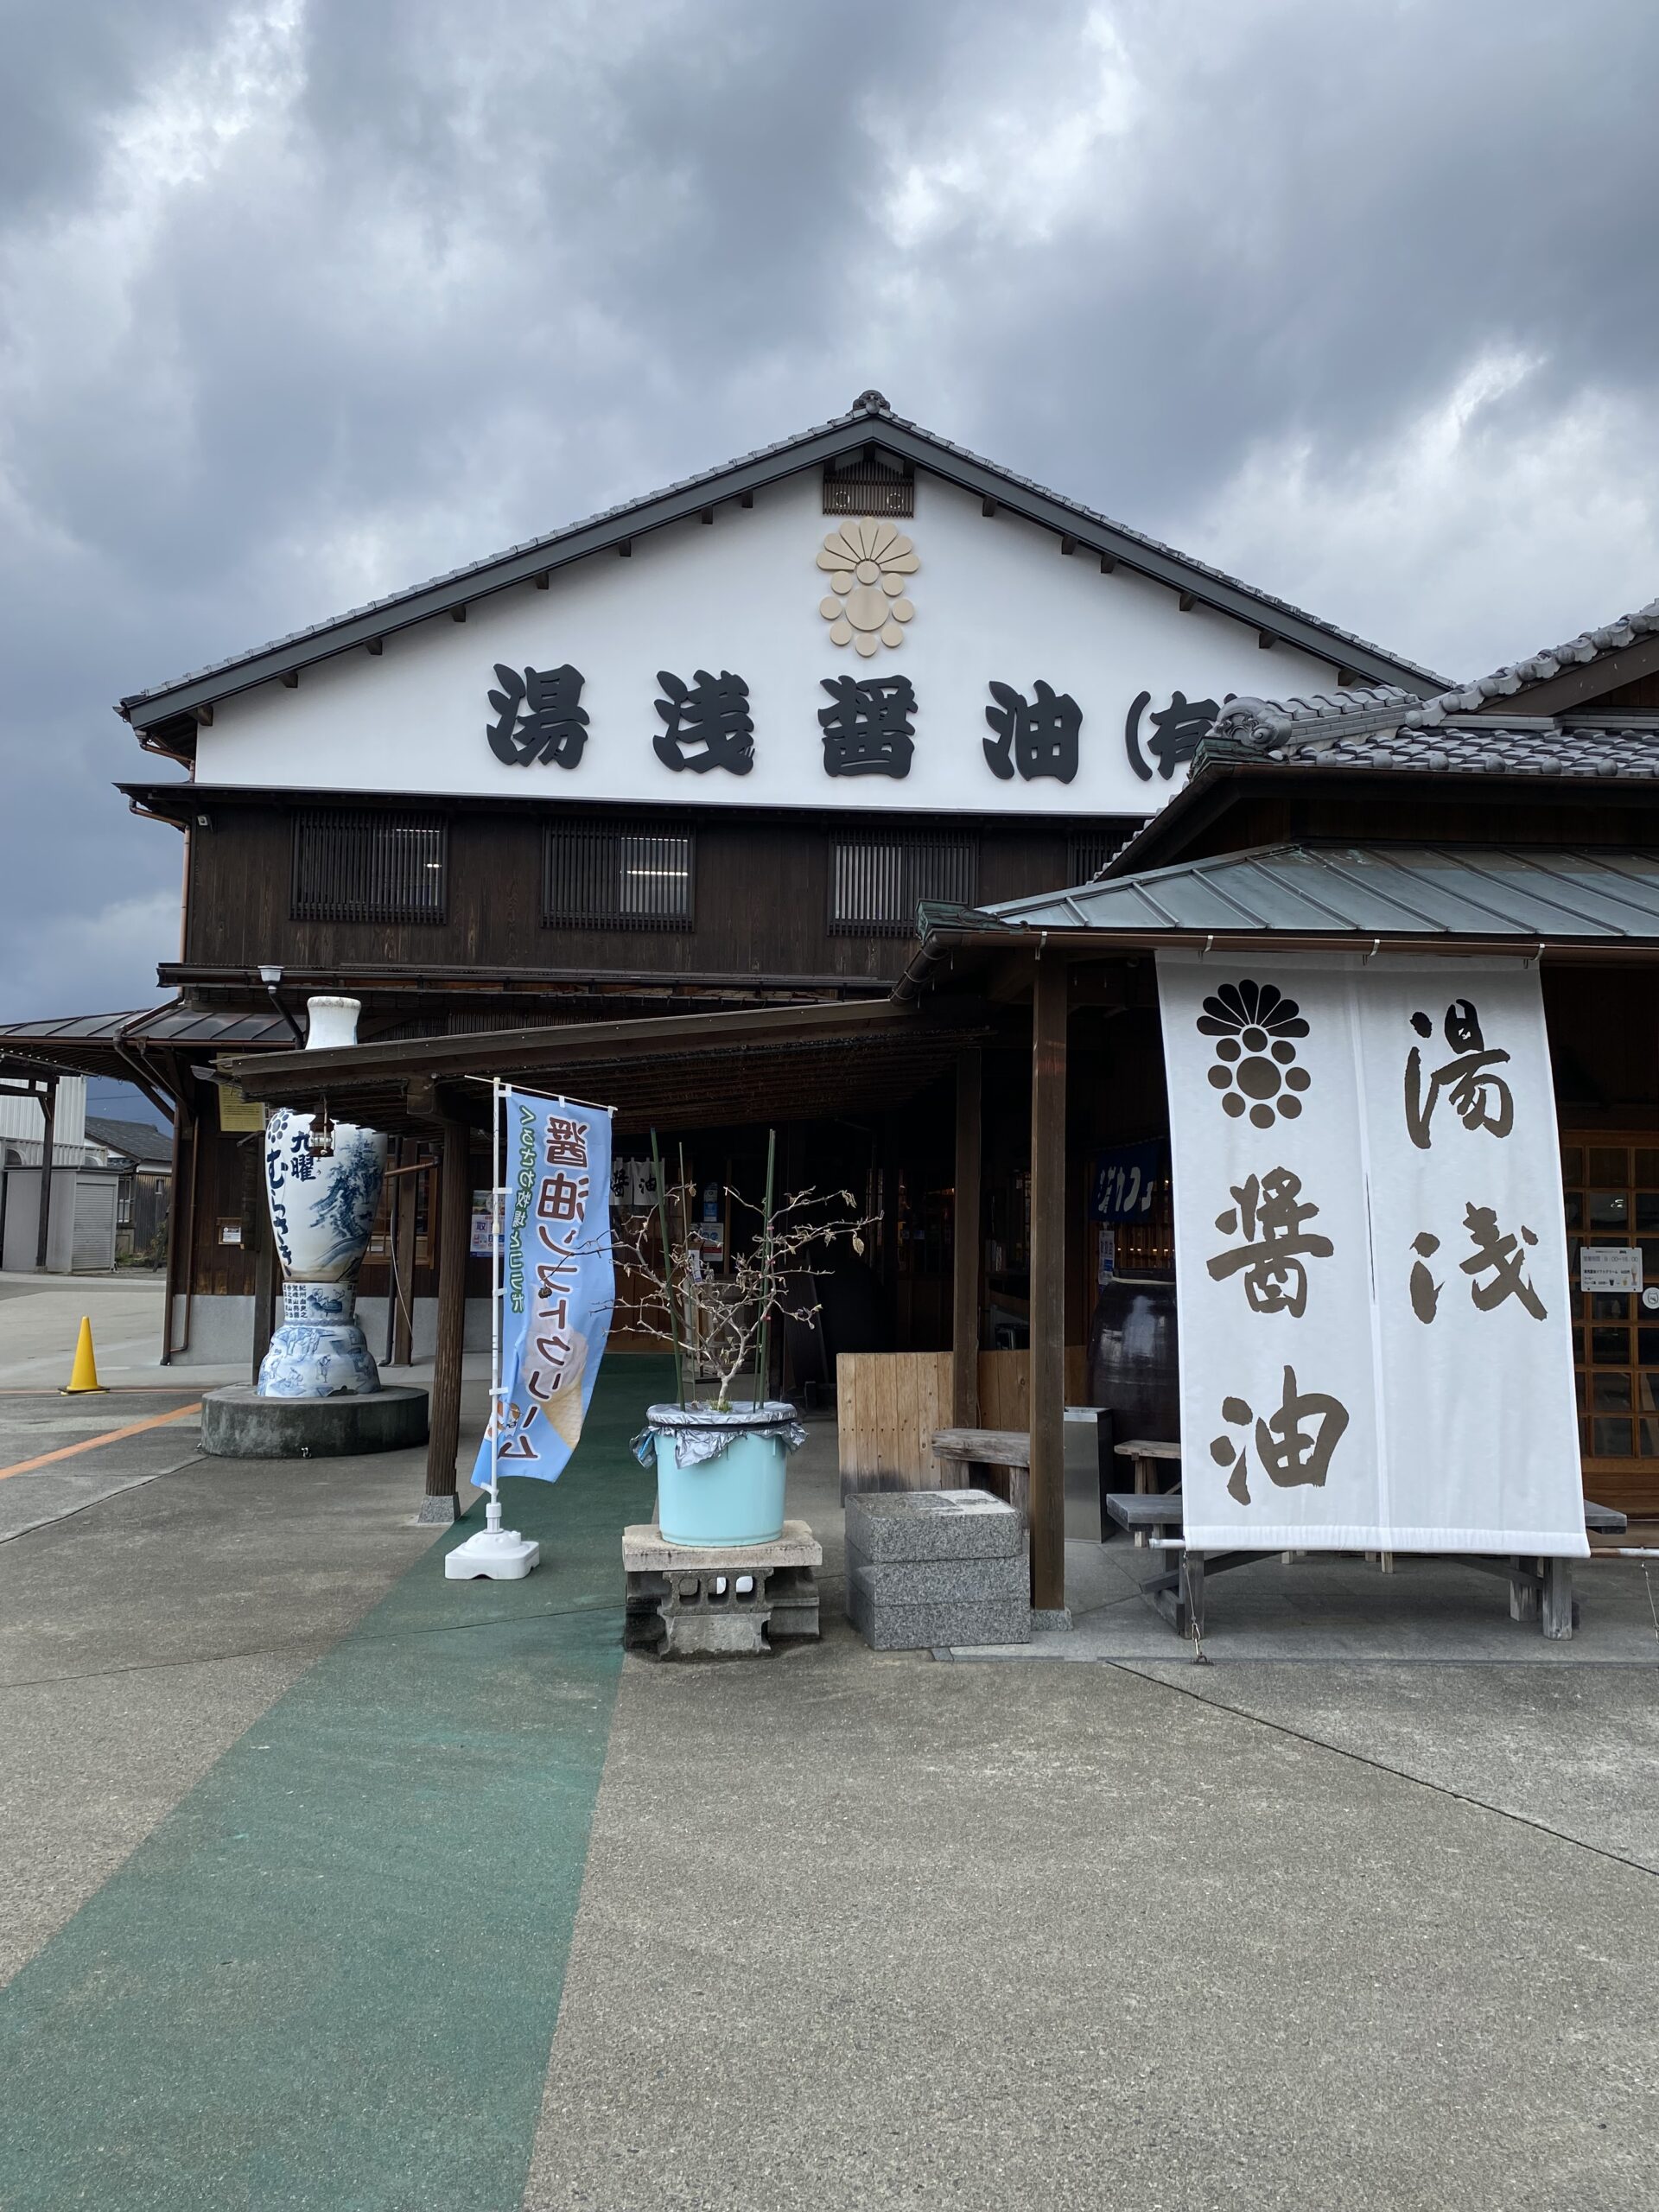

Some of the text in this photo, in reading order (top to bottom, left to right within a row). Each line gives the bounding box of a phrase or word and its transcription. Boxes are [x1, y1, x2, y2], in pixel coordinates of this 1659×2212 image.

[486, 663, 1236, 784] 湯浅醤油(有
[266, 1148, 293, 1277] むらさき
[290, 1130, 316, 1182] 九曜
[1404, 998, 1548, 1325] 湯浅
[1206, 1166, 1350, 1506] 醤油
